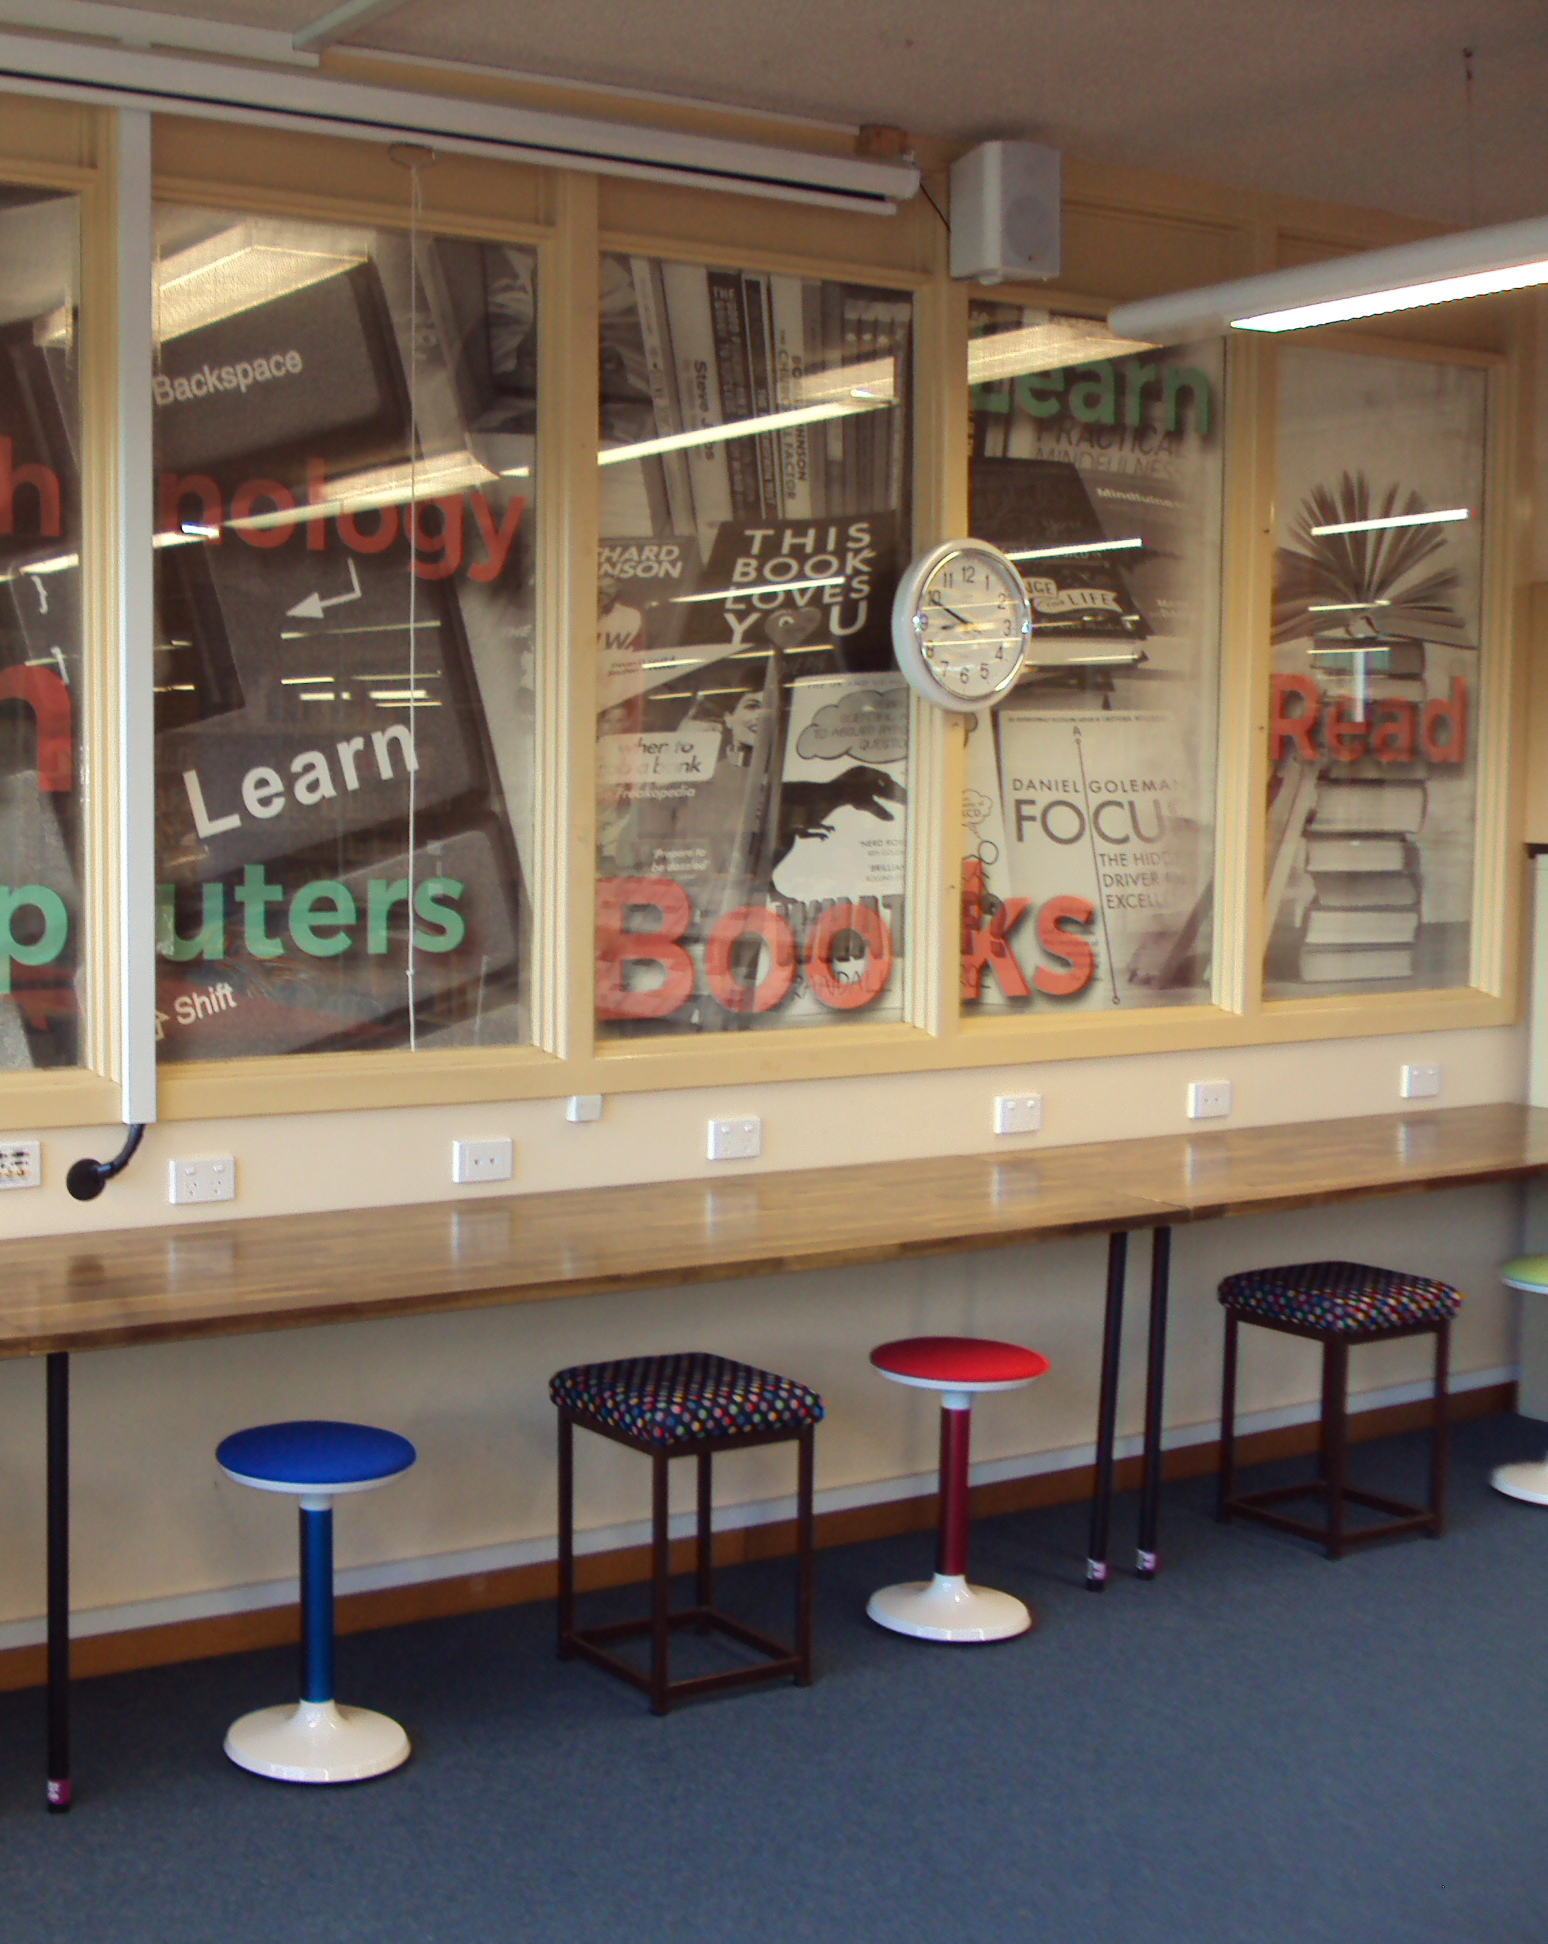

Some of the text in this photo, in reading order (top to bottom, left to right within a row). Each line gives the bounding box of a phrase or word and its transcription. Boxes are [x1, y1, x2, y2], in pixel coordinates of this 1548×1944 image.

[155, 347, 303, 406] Backspace
[694, 359, 712, 413] Steve
[700, 418, 717, 461] Jbs
[744, 522, 874, 555] THIS
[732, 548, 879, 583] BOOK
[961, 565, 976, 584] 12
[943, 571, 955, 588] 11
[725, 575, 871, 610] LOVES
[928, 590, 942, 605] 10
[997, 592, 1007, 609] 2
[1066, 592, 1111, 607] LIFE
[1002, 619, 1013, 637] 3
[995, 645, 1004, 660] 4
[940, 660, 949, 678] 7
[959, 667, 970, 684] 6
[980, 663, 990, 680] 5
[1270, 672, 1468, 764] Read
[653, 754, 702, 774] bnk
[183, 722, 420, 839] Learn
[1012, 778, 1178, 795] DANIEL GOLEMA
[1014, 798, 1172, 846] FOCU
[1098, 851, 1172, 867] THE HIDD
[1102, 871, 1159, 888] DRIVER
[1105, 892, 1166, 909] EXCELL
[175, 981, 237, 1026] Shift
